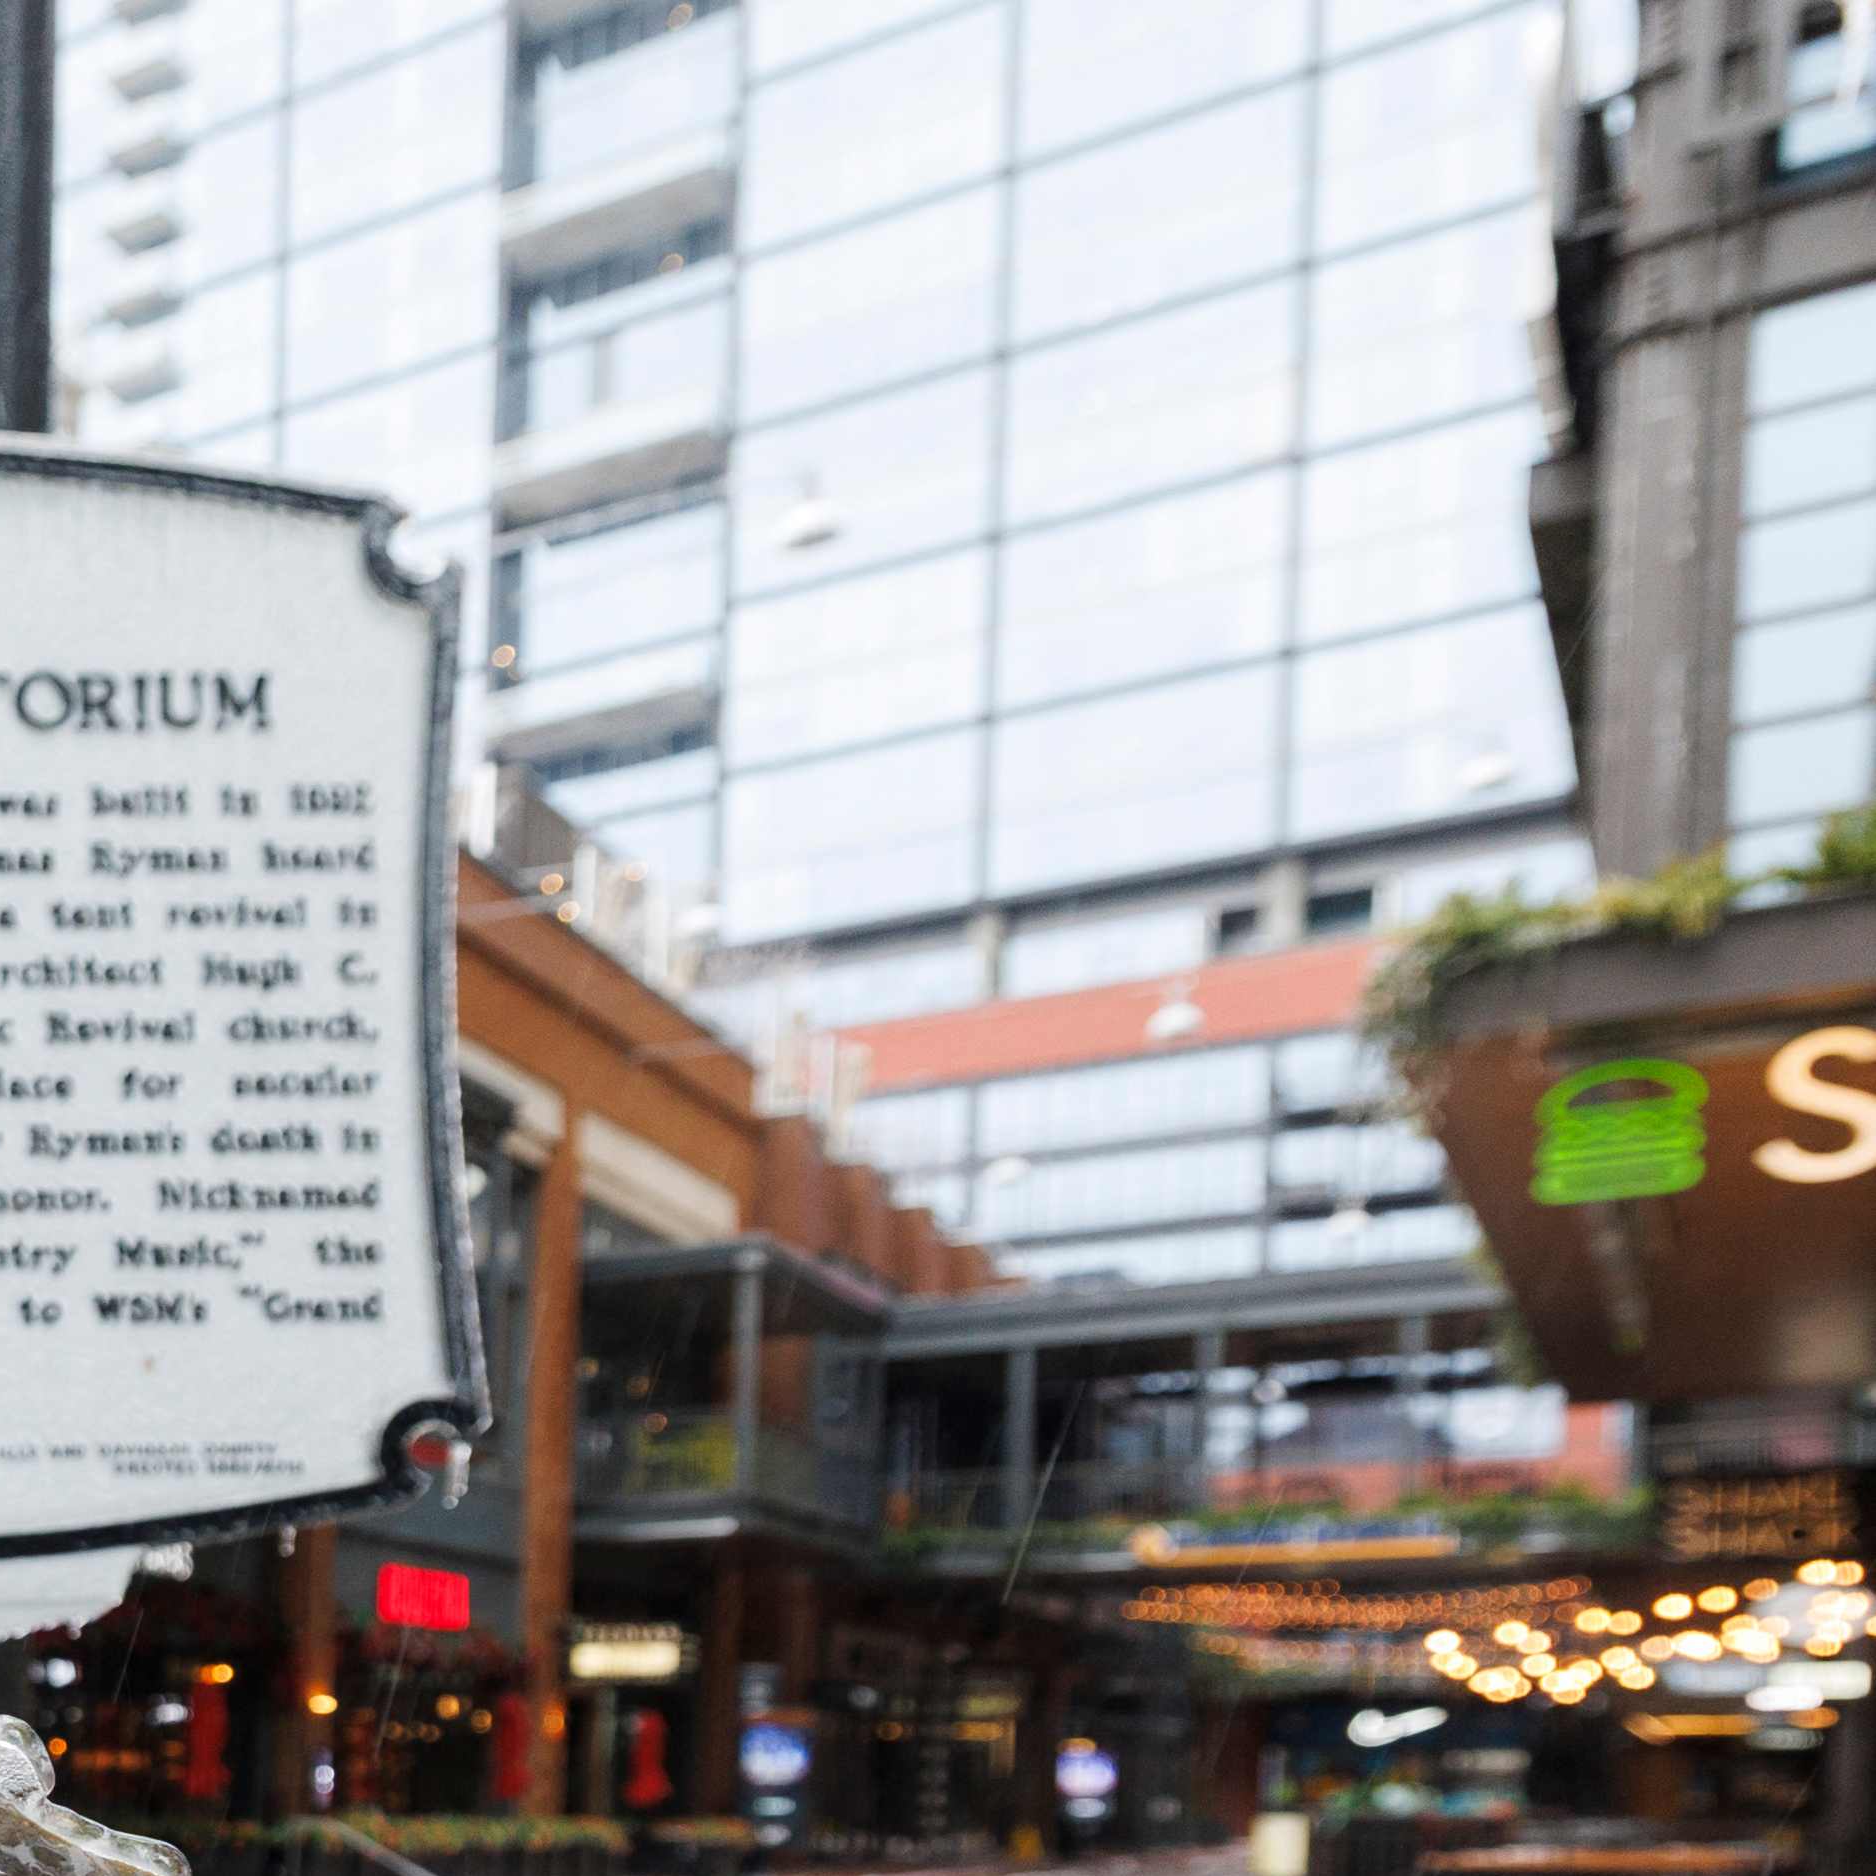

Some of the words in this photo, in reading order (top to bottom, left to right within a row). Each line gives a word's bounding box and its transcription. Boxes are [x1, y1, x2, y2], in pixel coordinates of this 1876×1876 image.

[90, 788, 189, 818] built
[219, 787, 259, 819] in
[89, 842, 228, 879] Ryman
[260, 842, 376, 873] heard
[49, 902, 133, 931] tent
[166, 898, 306, 929] revival
[337, 899, 378, 929] in
[201, 955, 299, 993] Hugh
[45, 1011, 195, 1045] Revival
[120, 1068, 180, 1100] for
[231, 1066, 378, 1099] secular
[1750, 1024, 1876, 1184] S
[208, 1125, 321, 1155] death
[341, 1124, 381, 1154] in
[155, 1179, 381, 1212] Nicknamed
[313, 1236, 383, 1267] the
[17, 1297, 63, 1326] to
